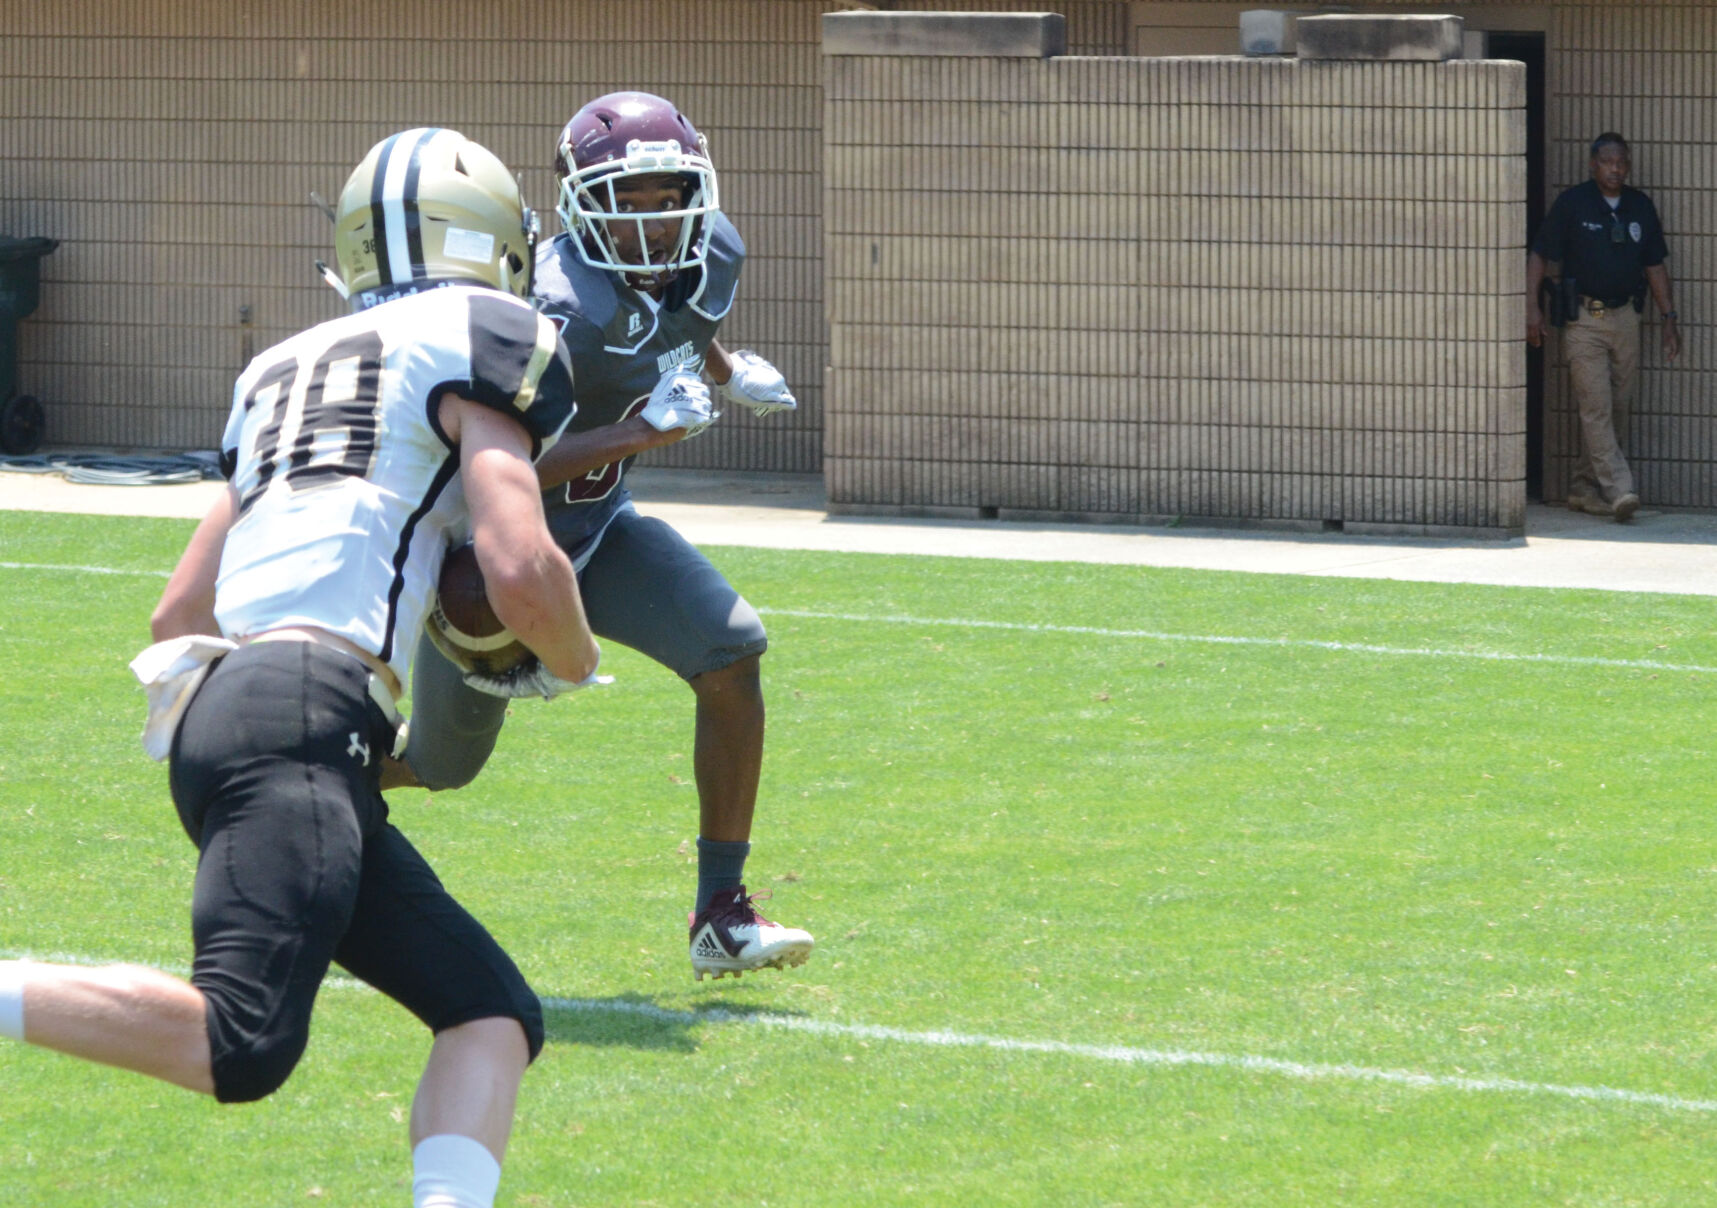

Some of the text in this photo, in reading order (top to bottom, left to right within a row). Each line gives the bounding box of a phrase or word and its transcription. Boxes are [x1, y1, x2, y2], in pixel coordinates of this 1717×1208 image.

[657, 340, 694, 373] WILDCATS
[664, 393, 693, 404] adidas
[240, 330, 384, 515] 38
[696, 948, 726, 959] adidas
